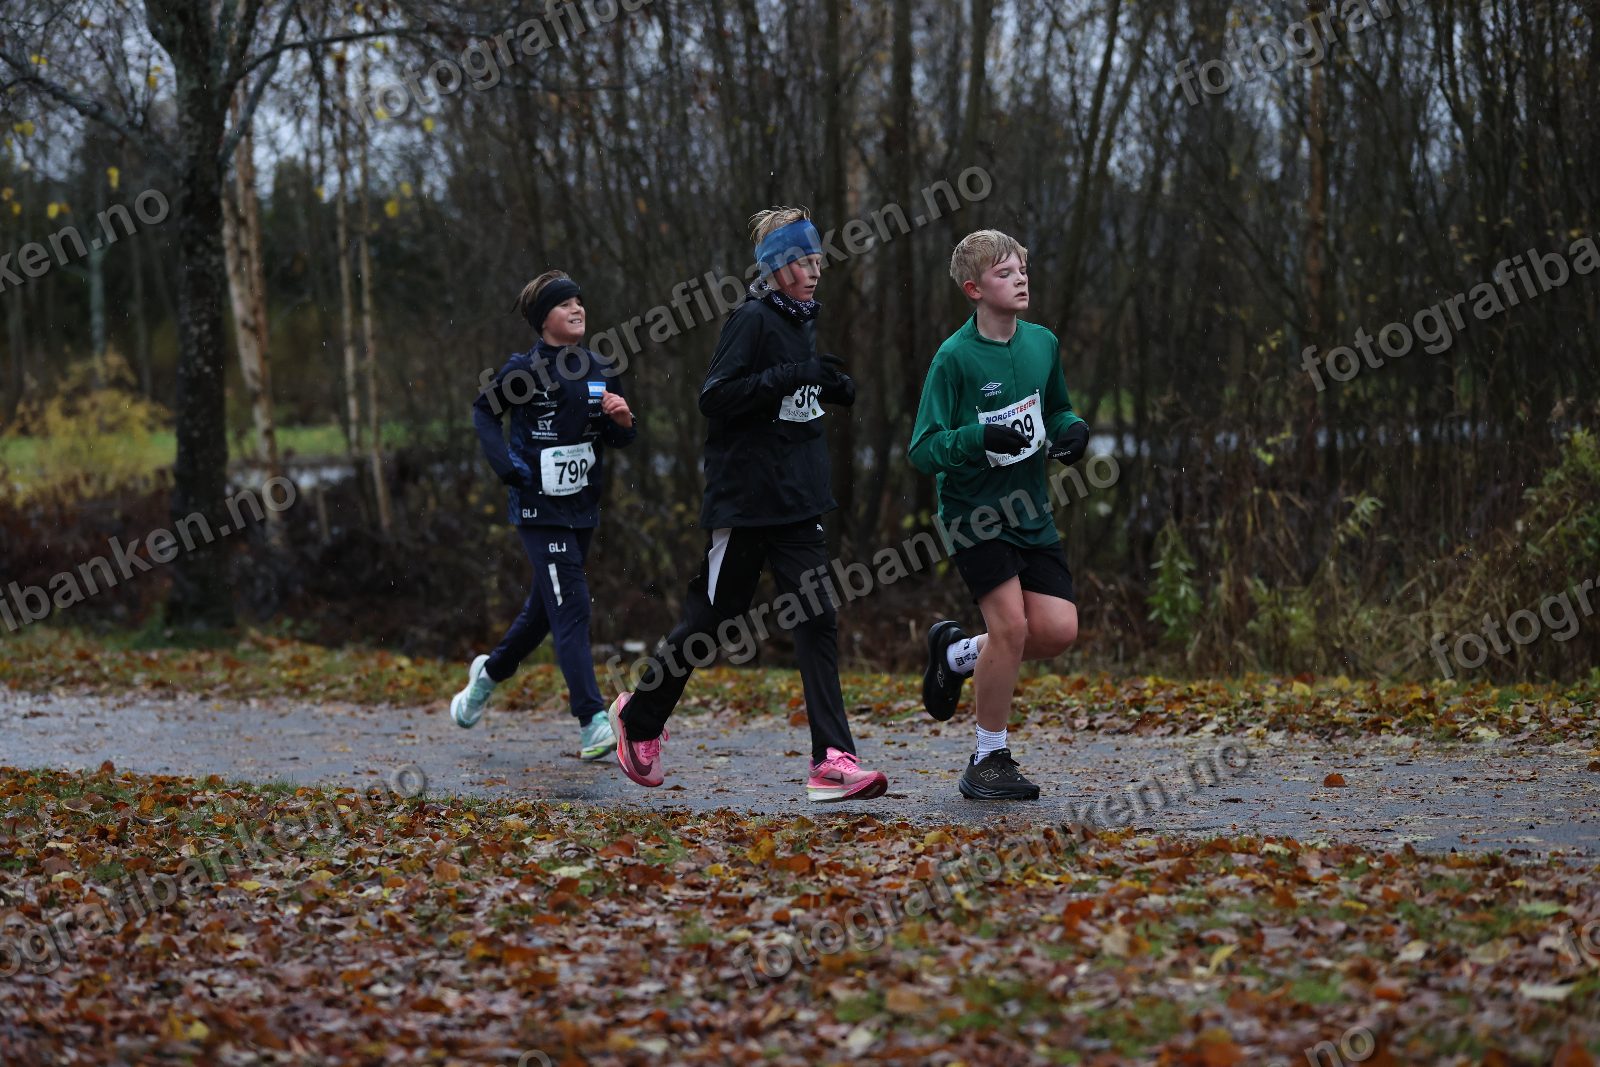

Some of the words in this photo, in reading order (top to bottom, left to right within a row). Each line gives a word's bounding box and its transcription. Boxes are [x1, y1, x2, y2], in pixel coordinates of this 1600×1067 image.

[985, 399, 1036, 424] NORGESTESTEN
[537, 420, 553, 431] EY
[554, 458, 588, 485] 790
[522, 508, 538, 518] GLJ
[548, 541, 567, 553] GLJ
